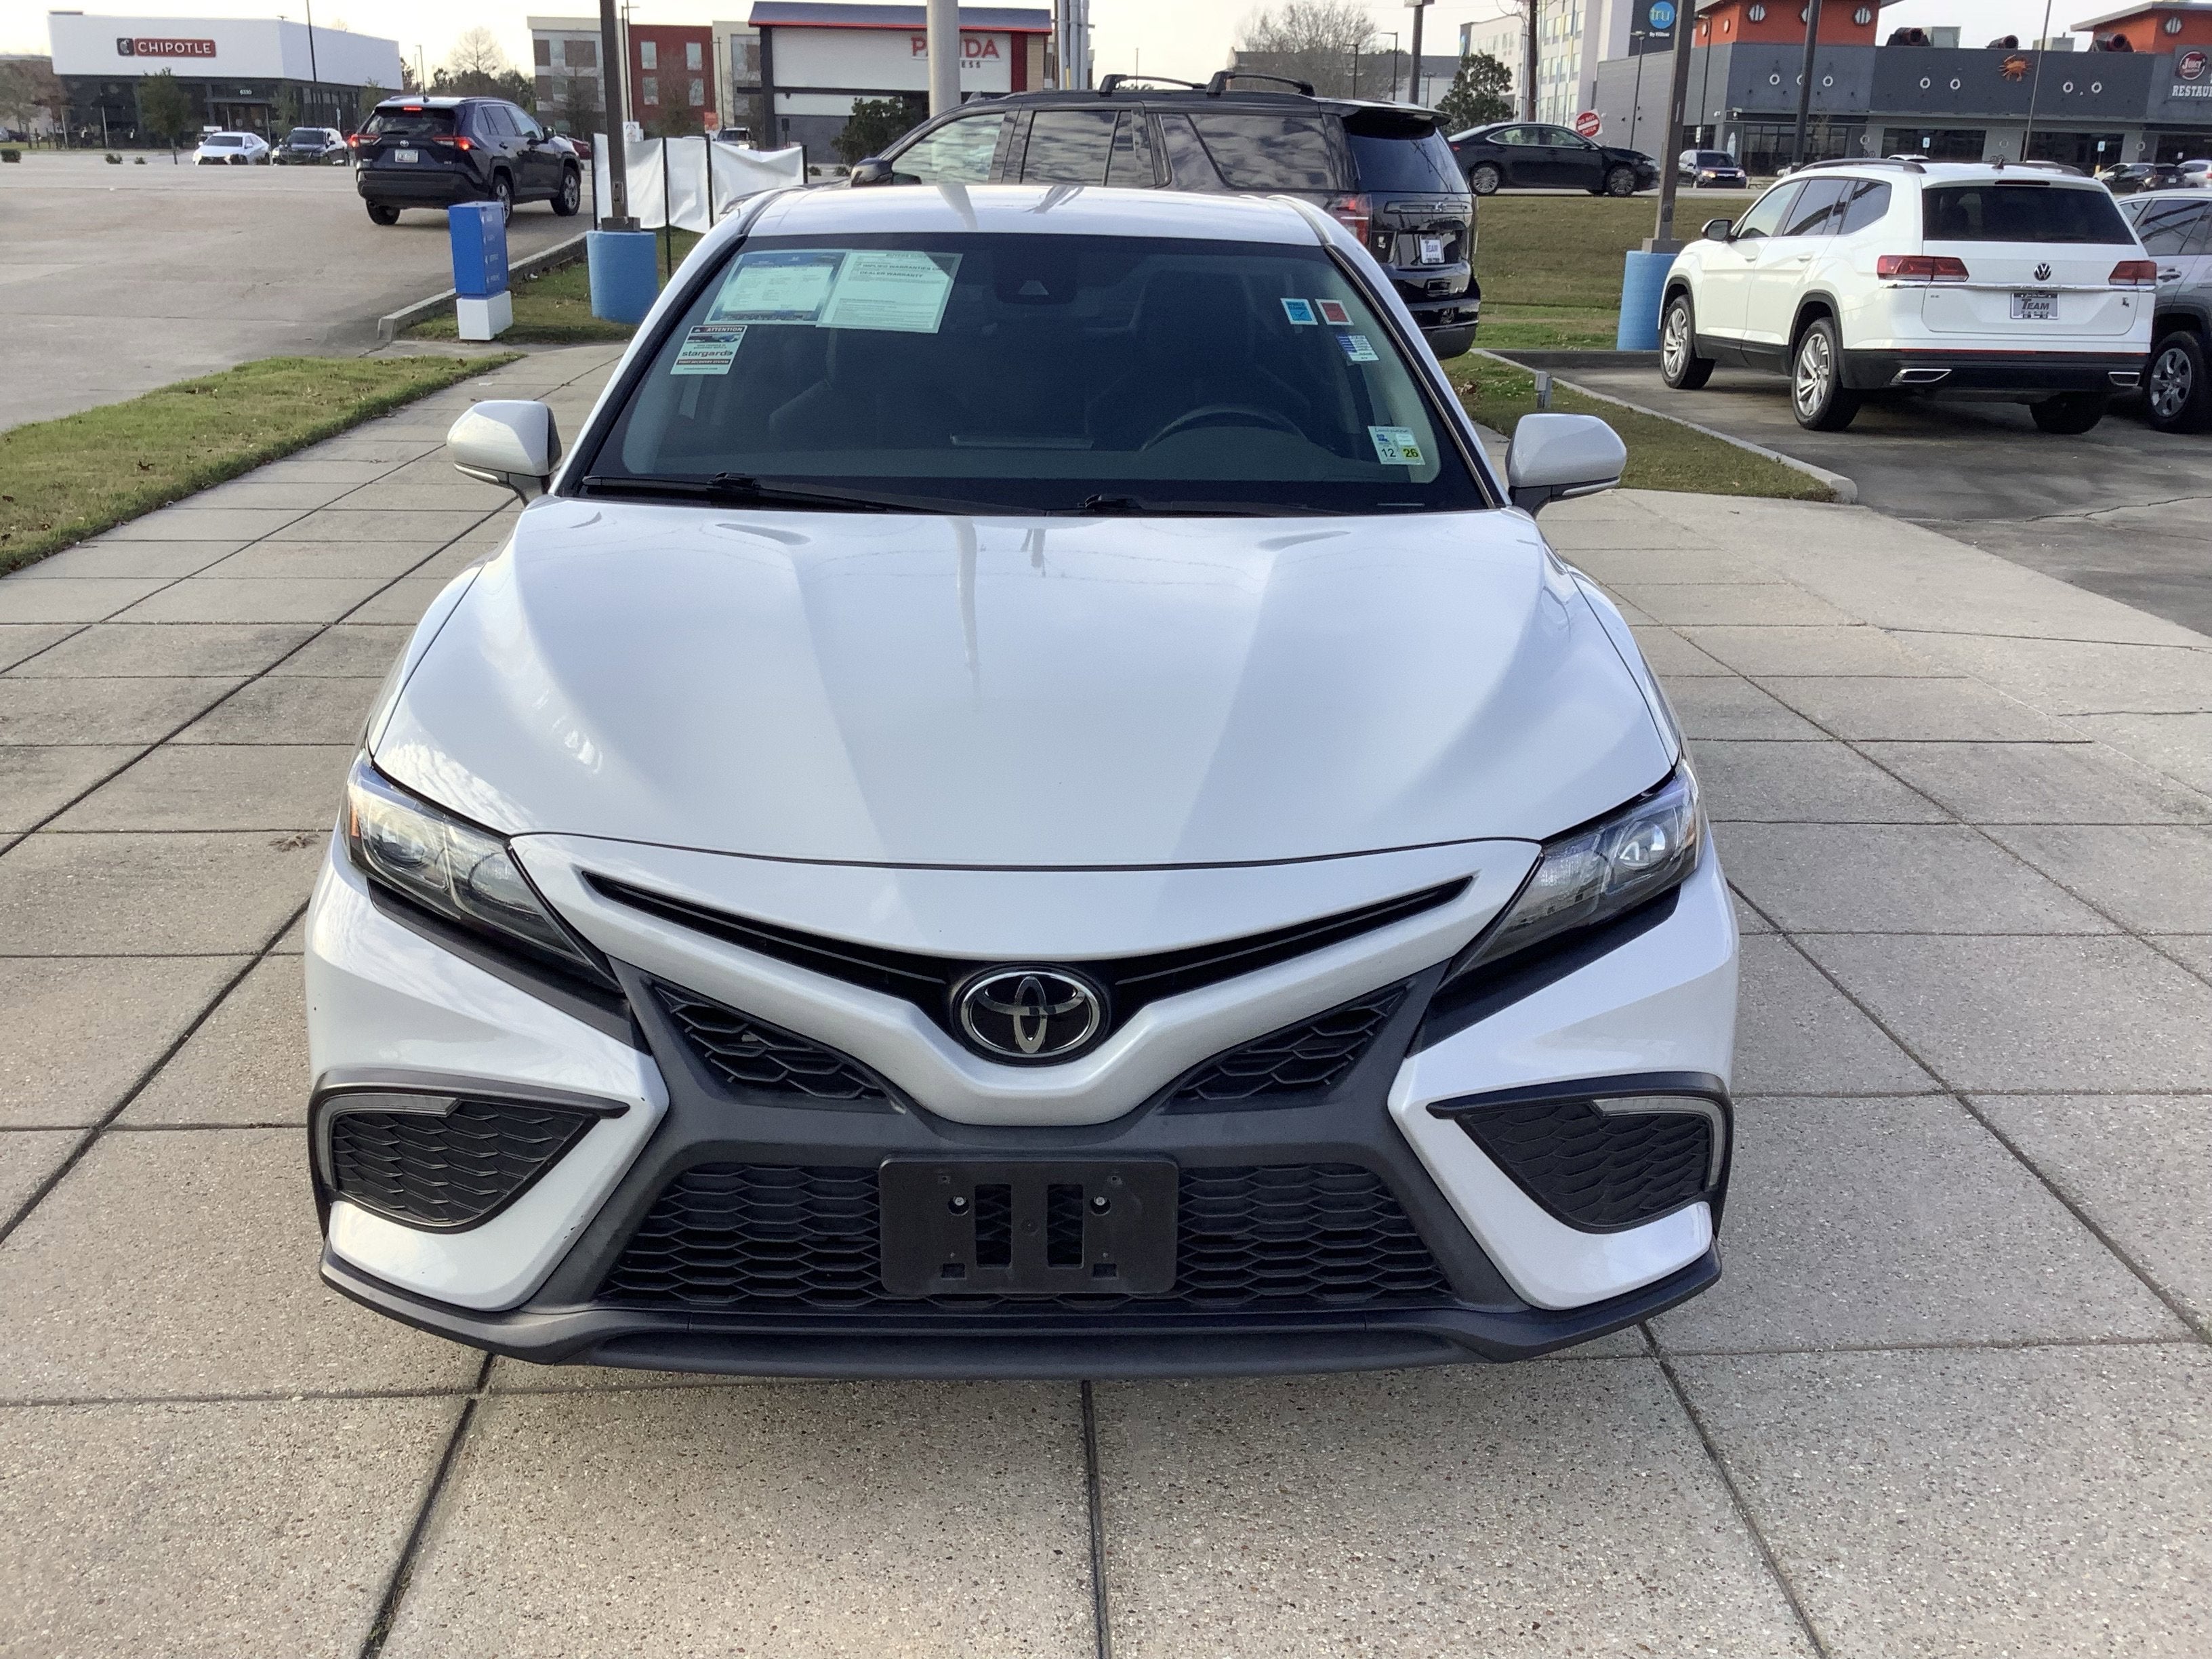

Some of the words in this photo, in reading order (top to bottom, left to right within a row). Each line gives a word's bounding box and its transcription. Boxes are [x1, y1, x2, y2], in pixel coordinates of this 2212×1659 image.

[1650, 7, 1670, 21] tru
[138, 41, 212, 54] CHIPOTLE
[1381, 448, 1396, 457] 12
[1403, 449, 1418, 457] 26
